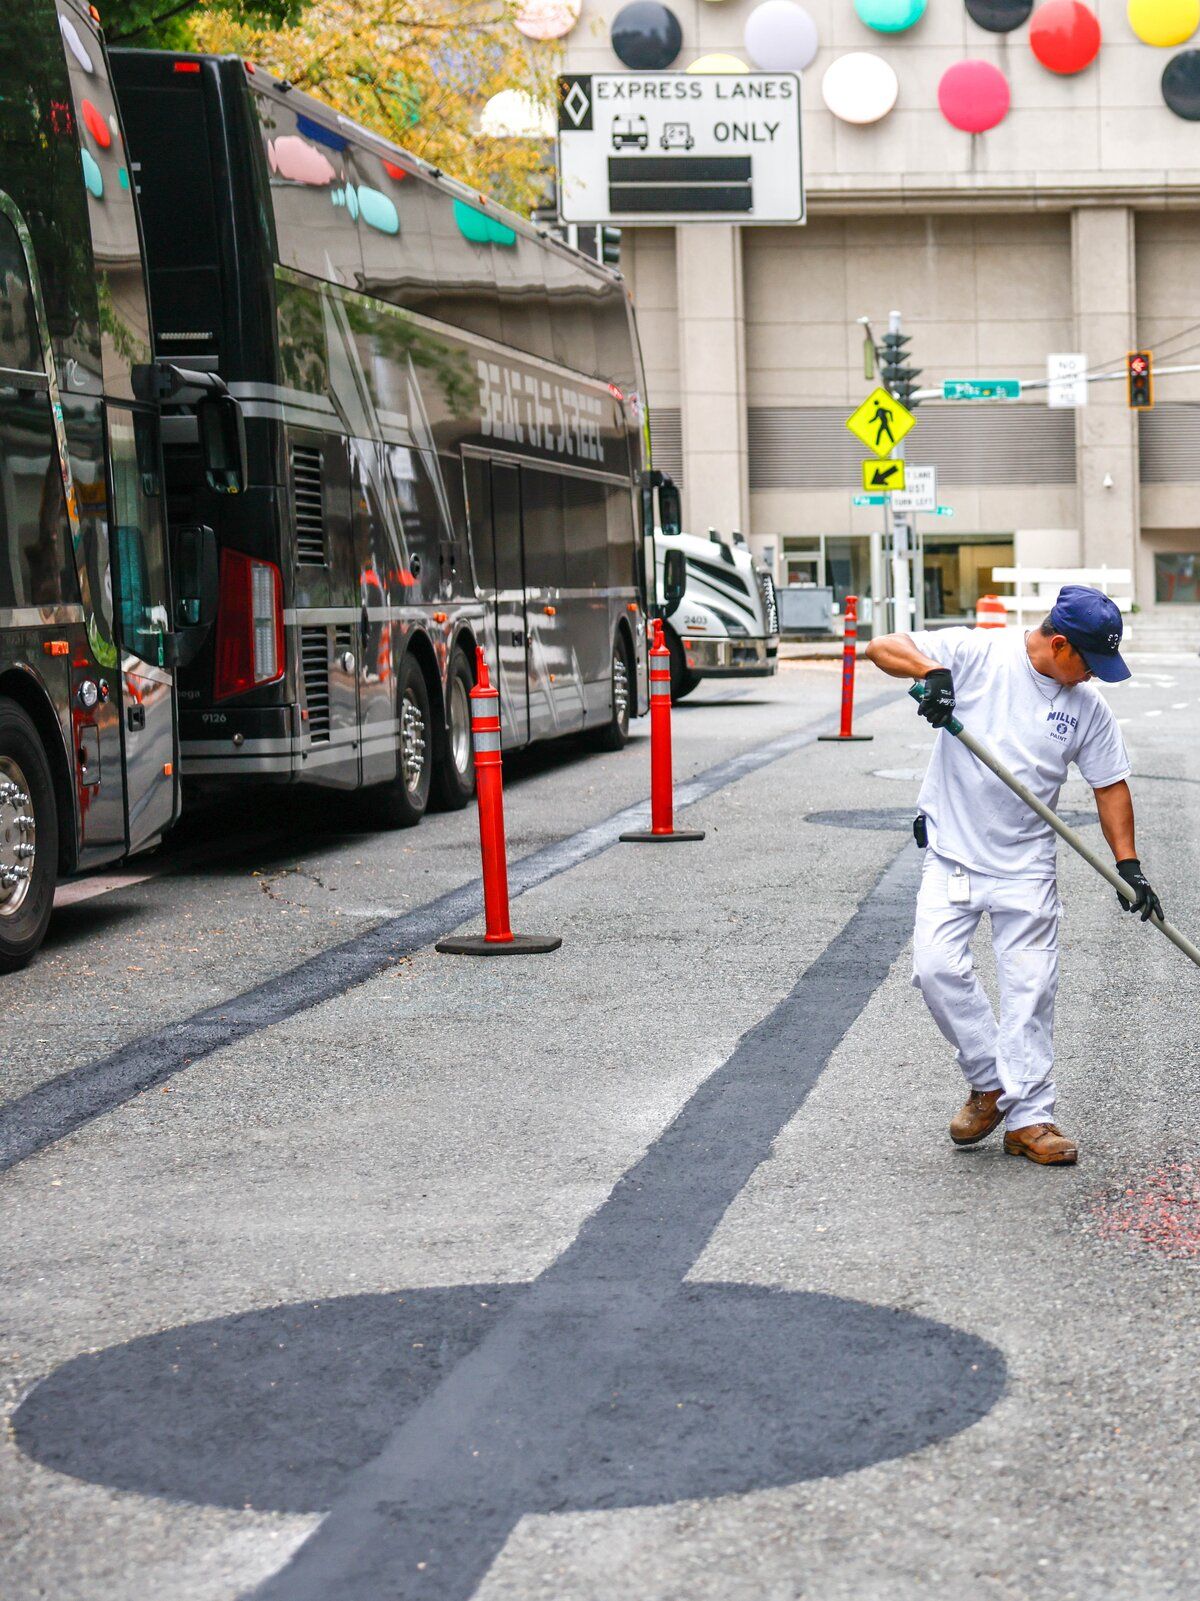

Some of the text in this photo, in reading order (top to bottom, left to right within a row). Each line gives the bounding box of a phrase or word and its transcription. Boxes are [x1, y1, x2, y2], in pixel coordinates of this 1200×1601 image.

[597, 81, 792, 99] EXPRESS LANES
[713, 121, 780, 142] ONLY
[202, 712, 228, 723] 9126
[1050, 732, 1067, 742] PAINT
